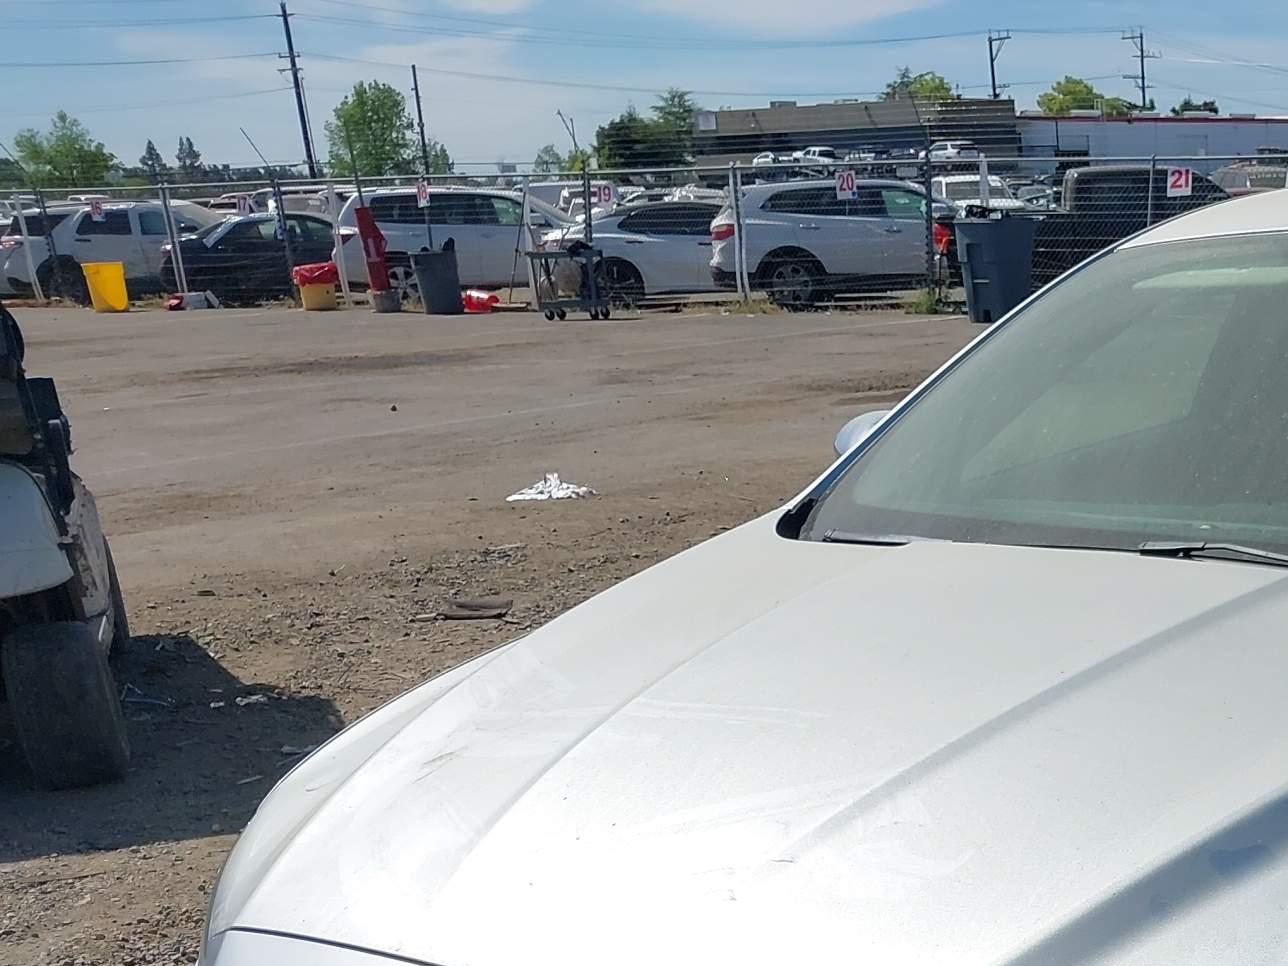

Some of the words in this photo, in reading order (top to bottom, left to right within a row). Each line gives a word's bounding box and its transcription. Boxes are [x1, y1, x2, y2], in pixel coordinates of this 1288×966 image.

[838, 173, 854, 191] 20
[1170, 169, 1190, 188] 21
[417, 184, 428, 200] 18
[598, 185, 612, 202] 19
[91, 201, 103, 216] 16
